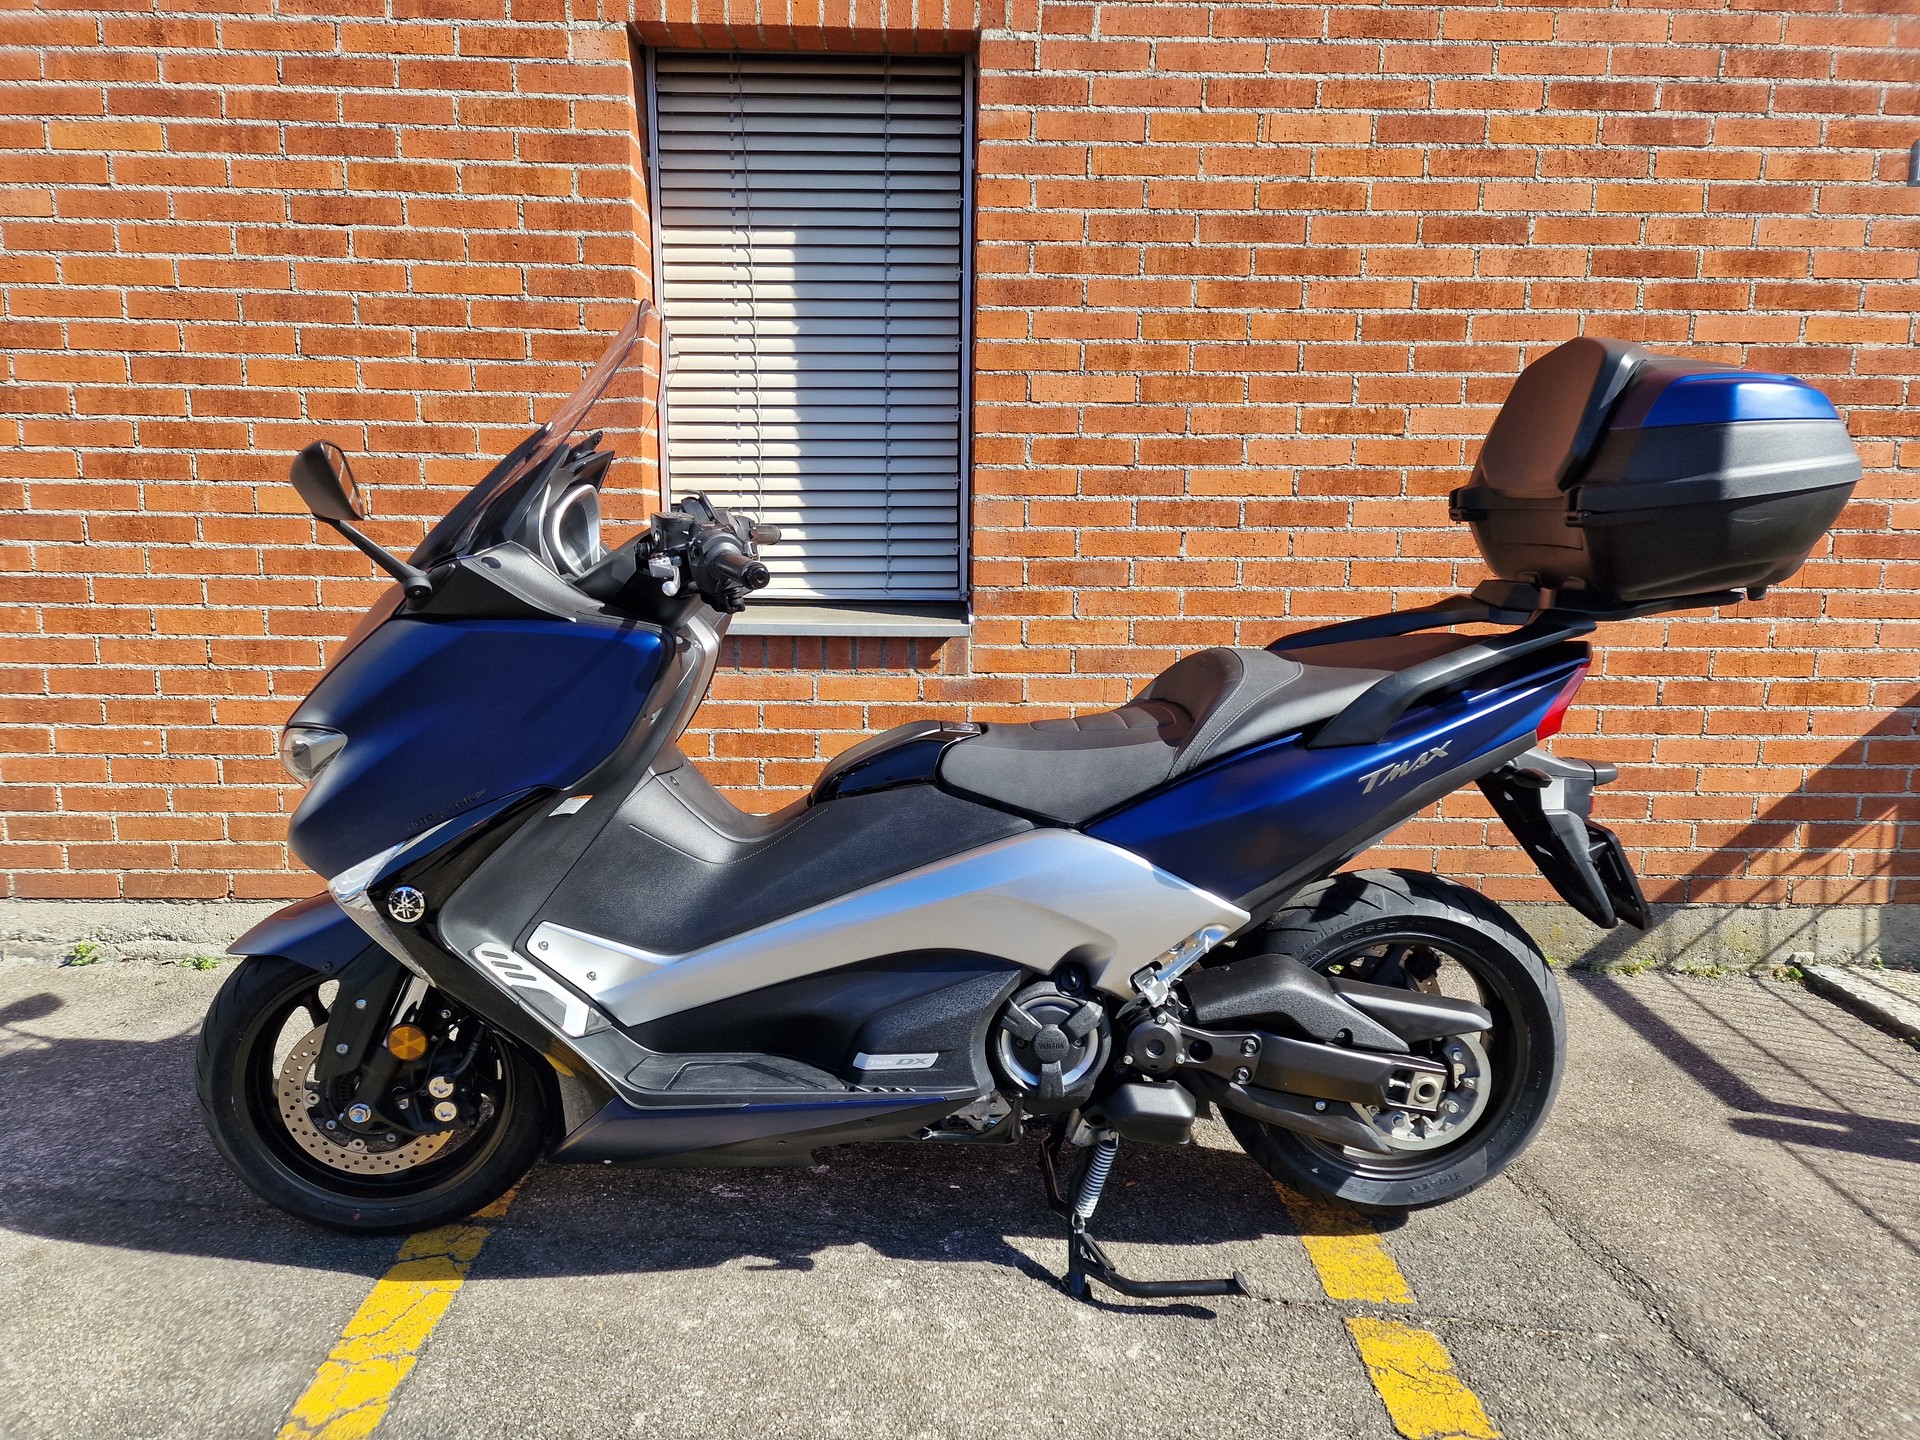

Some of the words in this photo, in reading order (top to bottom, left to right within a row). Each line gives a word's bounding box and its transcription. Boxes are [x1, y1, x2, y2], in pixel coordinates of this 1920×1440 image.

[1341, 920, 1399, 941] ROSSO
[1038, 1040, 1065, 1050] YAMAHA
[894, 1057, 930, 1066] DX
